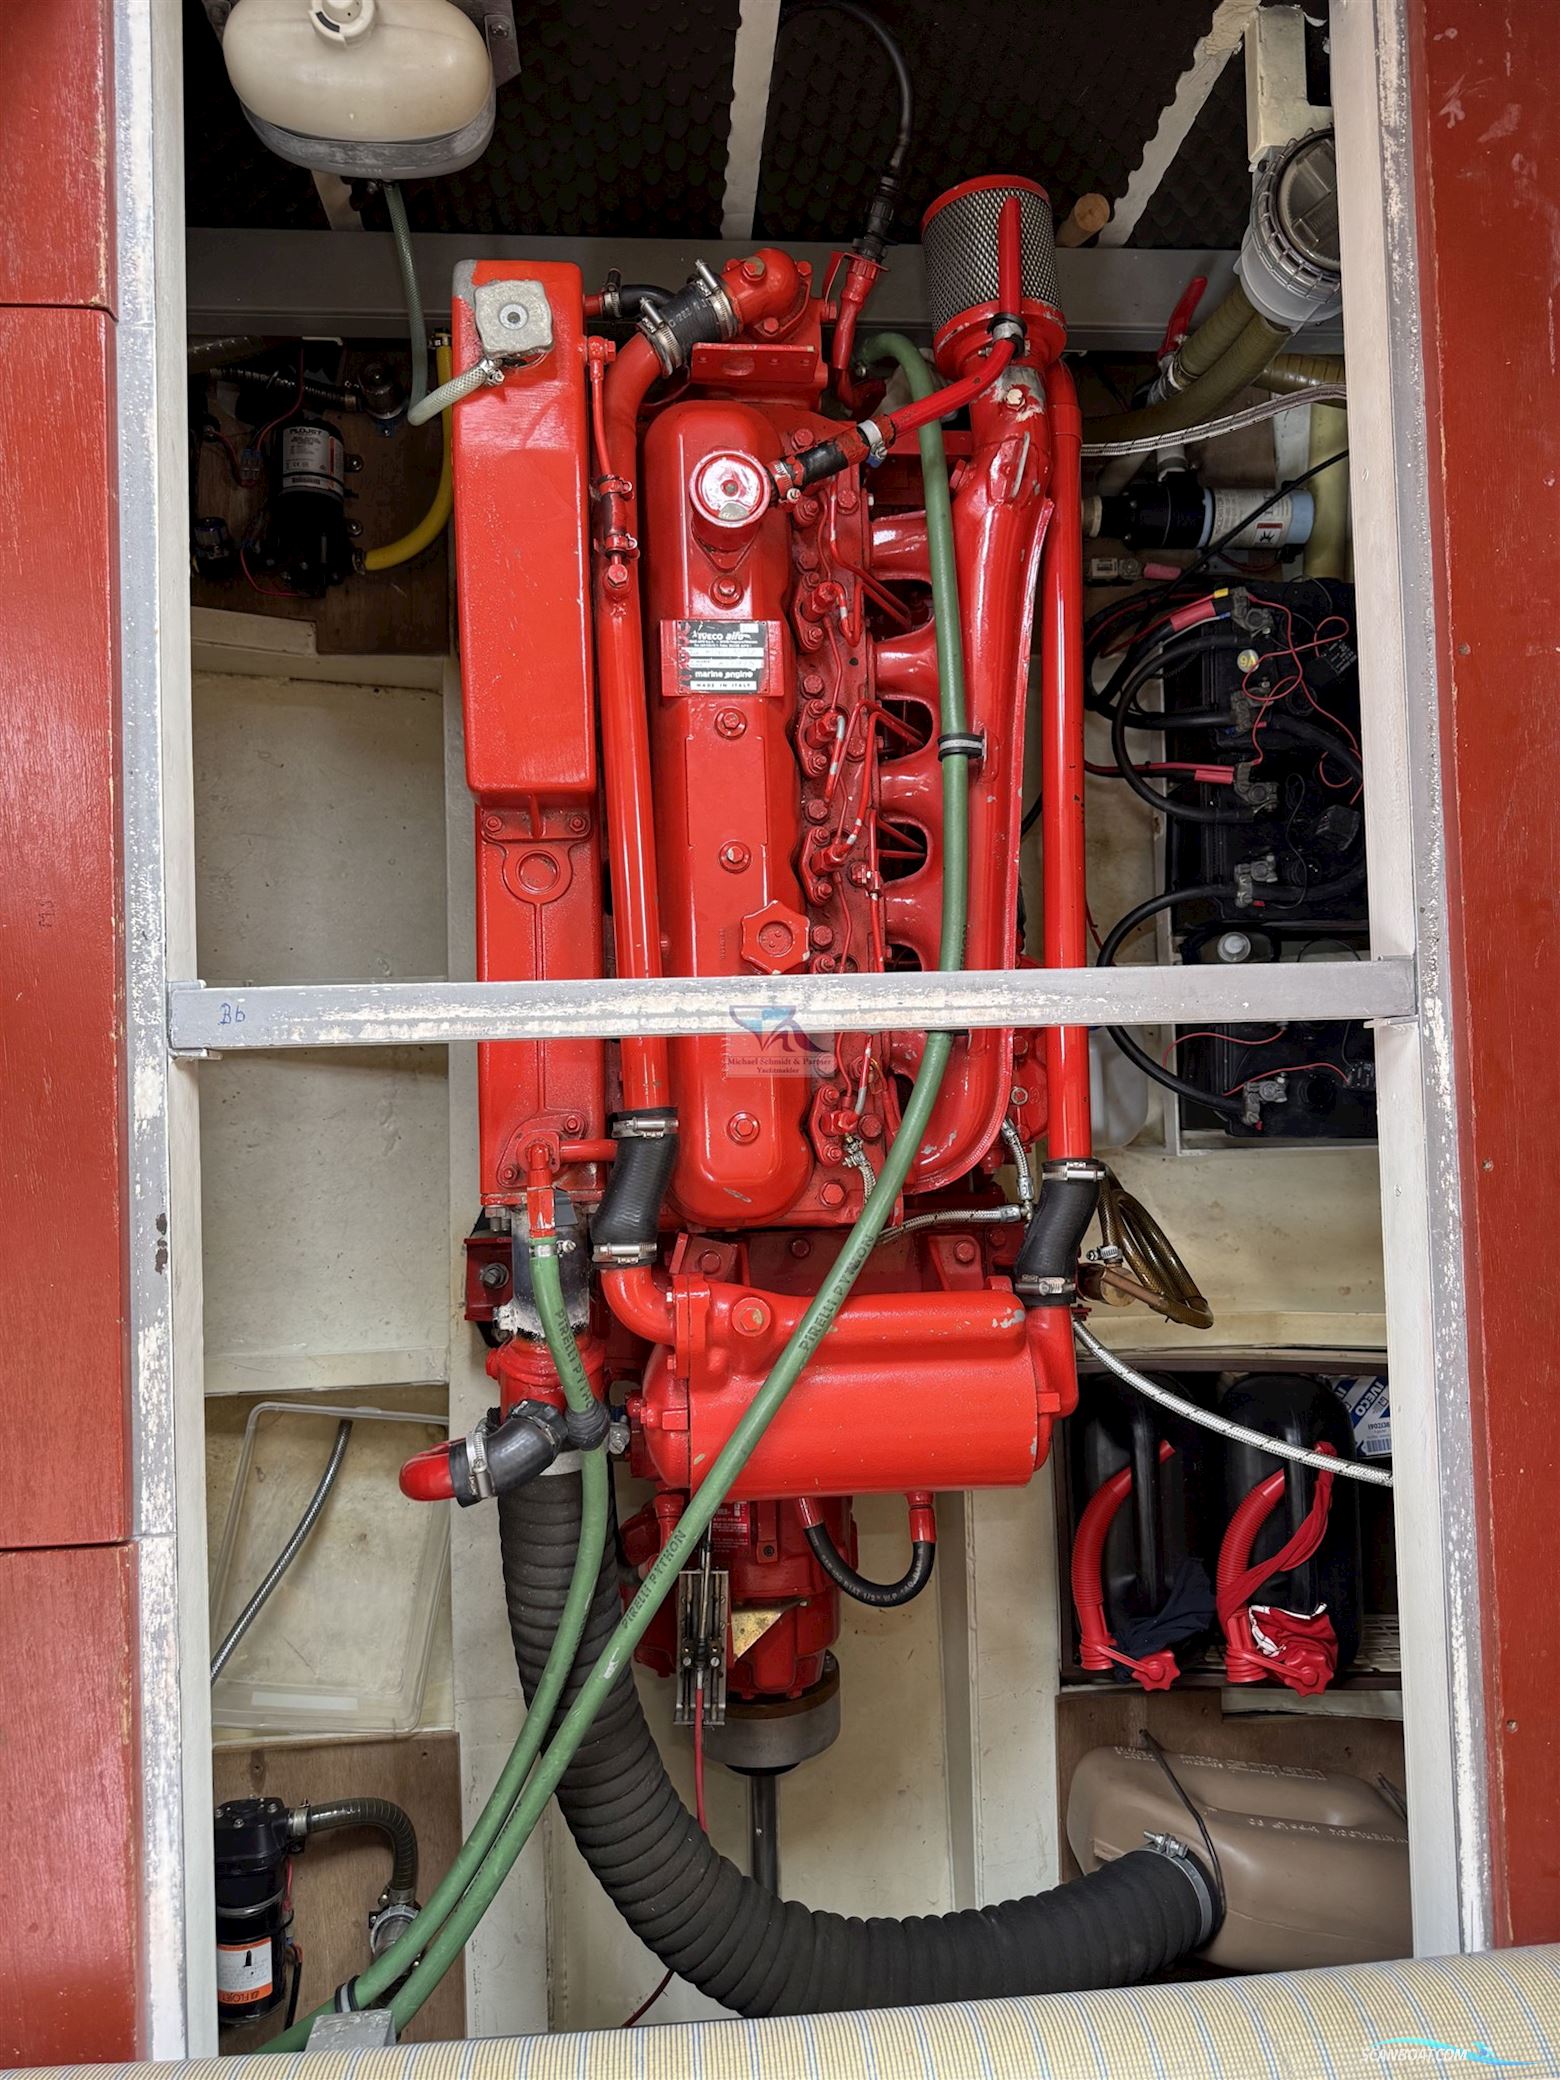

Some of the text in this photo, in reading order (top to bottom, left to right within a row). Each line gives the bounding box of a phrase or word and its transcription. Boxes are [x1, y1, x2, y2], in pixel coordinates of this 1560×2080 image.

[724, 671, 753, 679] engine
[555, 1308, 579, 1362] PIRELLI
[798, 1299, 838, 1352] PIRELLI
[1355, 1381, 1384, 1417] IVECO
[620, 1529, 687, 1629] PIRELLI PYTHON
